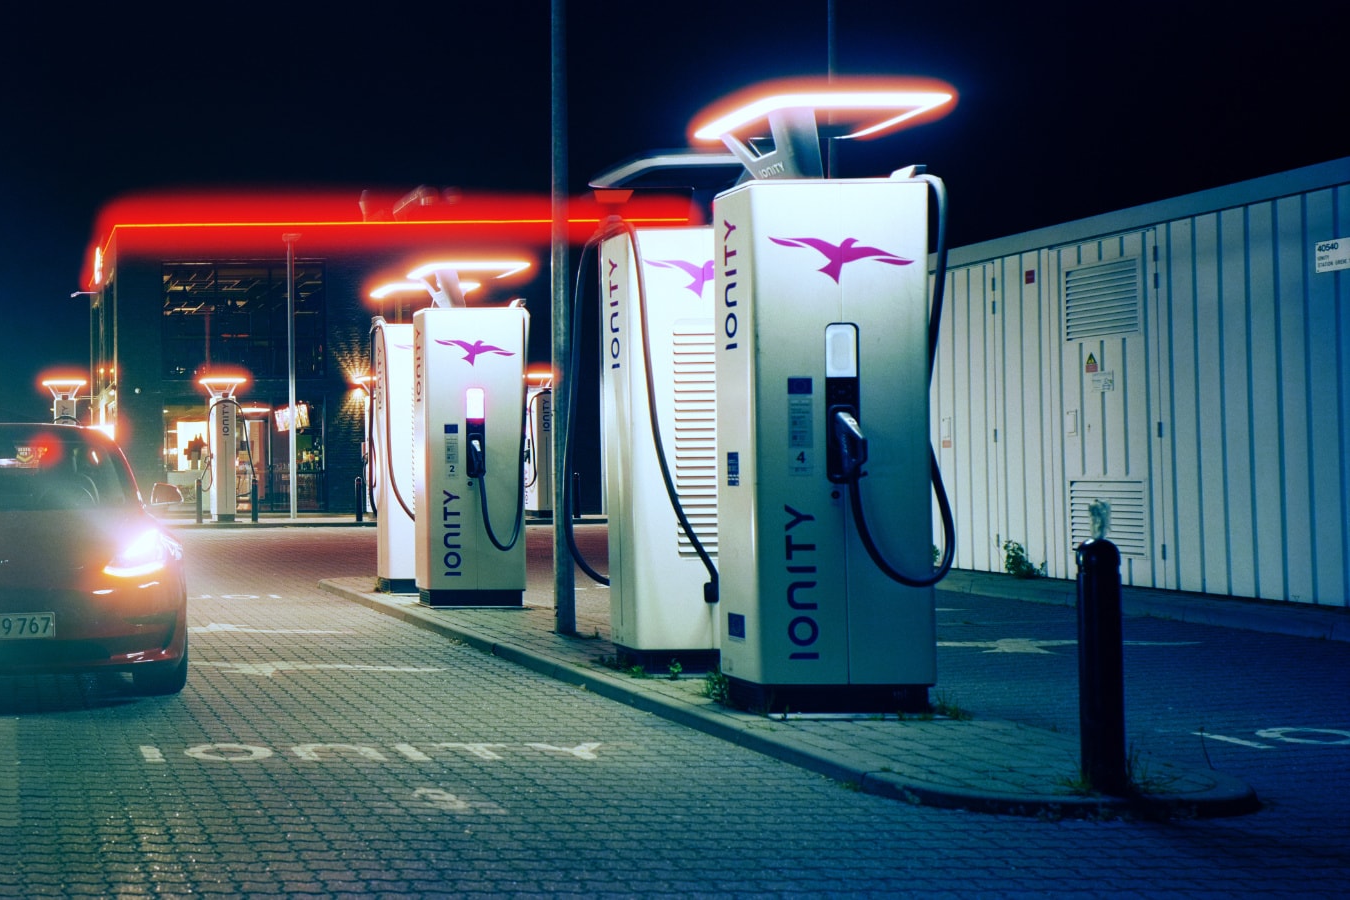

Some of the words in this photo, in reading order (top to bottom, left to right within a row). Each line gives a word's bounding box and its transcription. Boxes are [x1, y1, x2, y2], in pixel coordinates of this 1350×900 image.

[758, 161, 785, 178] IONITY
[722, 218, 738, 352] IONITY
[608, 257, 620, 370] IONITY
[221, 403, 230, 436] IONITY
[542, 398, 551, 432] IONITY
[449, 465, 455, 473] 2
[796, 451, 805, 464] 4
[442, 490, 462, 577] IONITY
[784, 504, 820, 661] IONITY
[17, 616, 51, 635] 767
[139, 743, 603, 763] IONITY
